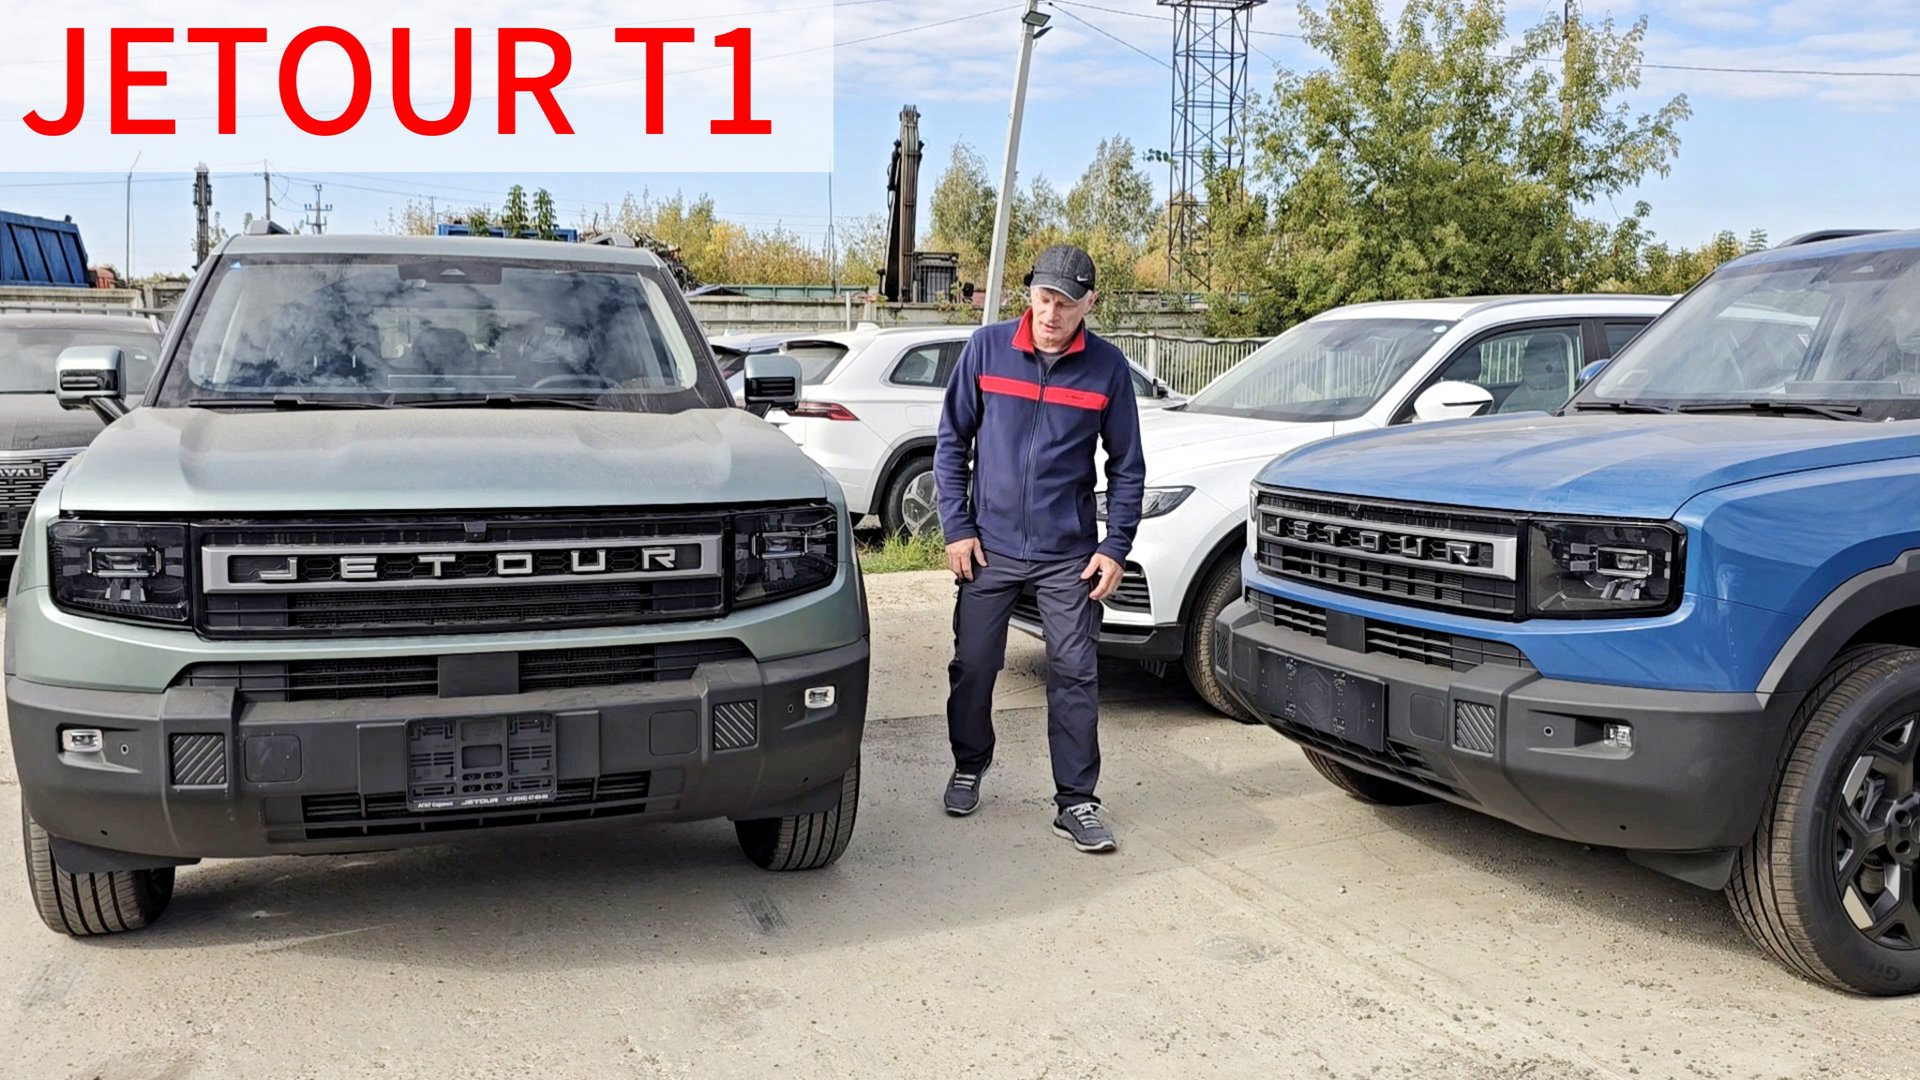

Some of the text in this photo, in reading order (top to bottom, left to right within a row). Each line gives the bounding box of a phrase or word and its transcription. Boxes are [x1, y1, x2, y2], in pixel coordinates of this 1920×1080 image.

[1267, 516, 1472, 564] JETOUR
[258, 547, 677, 582] JETOUR
[462, 797, 499, 806] JETOUR
